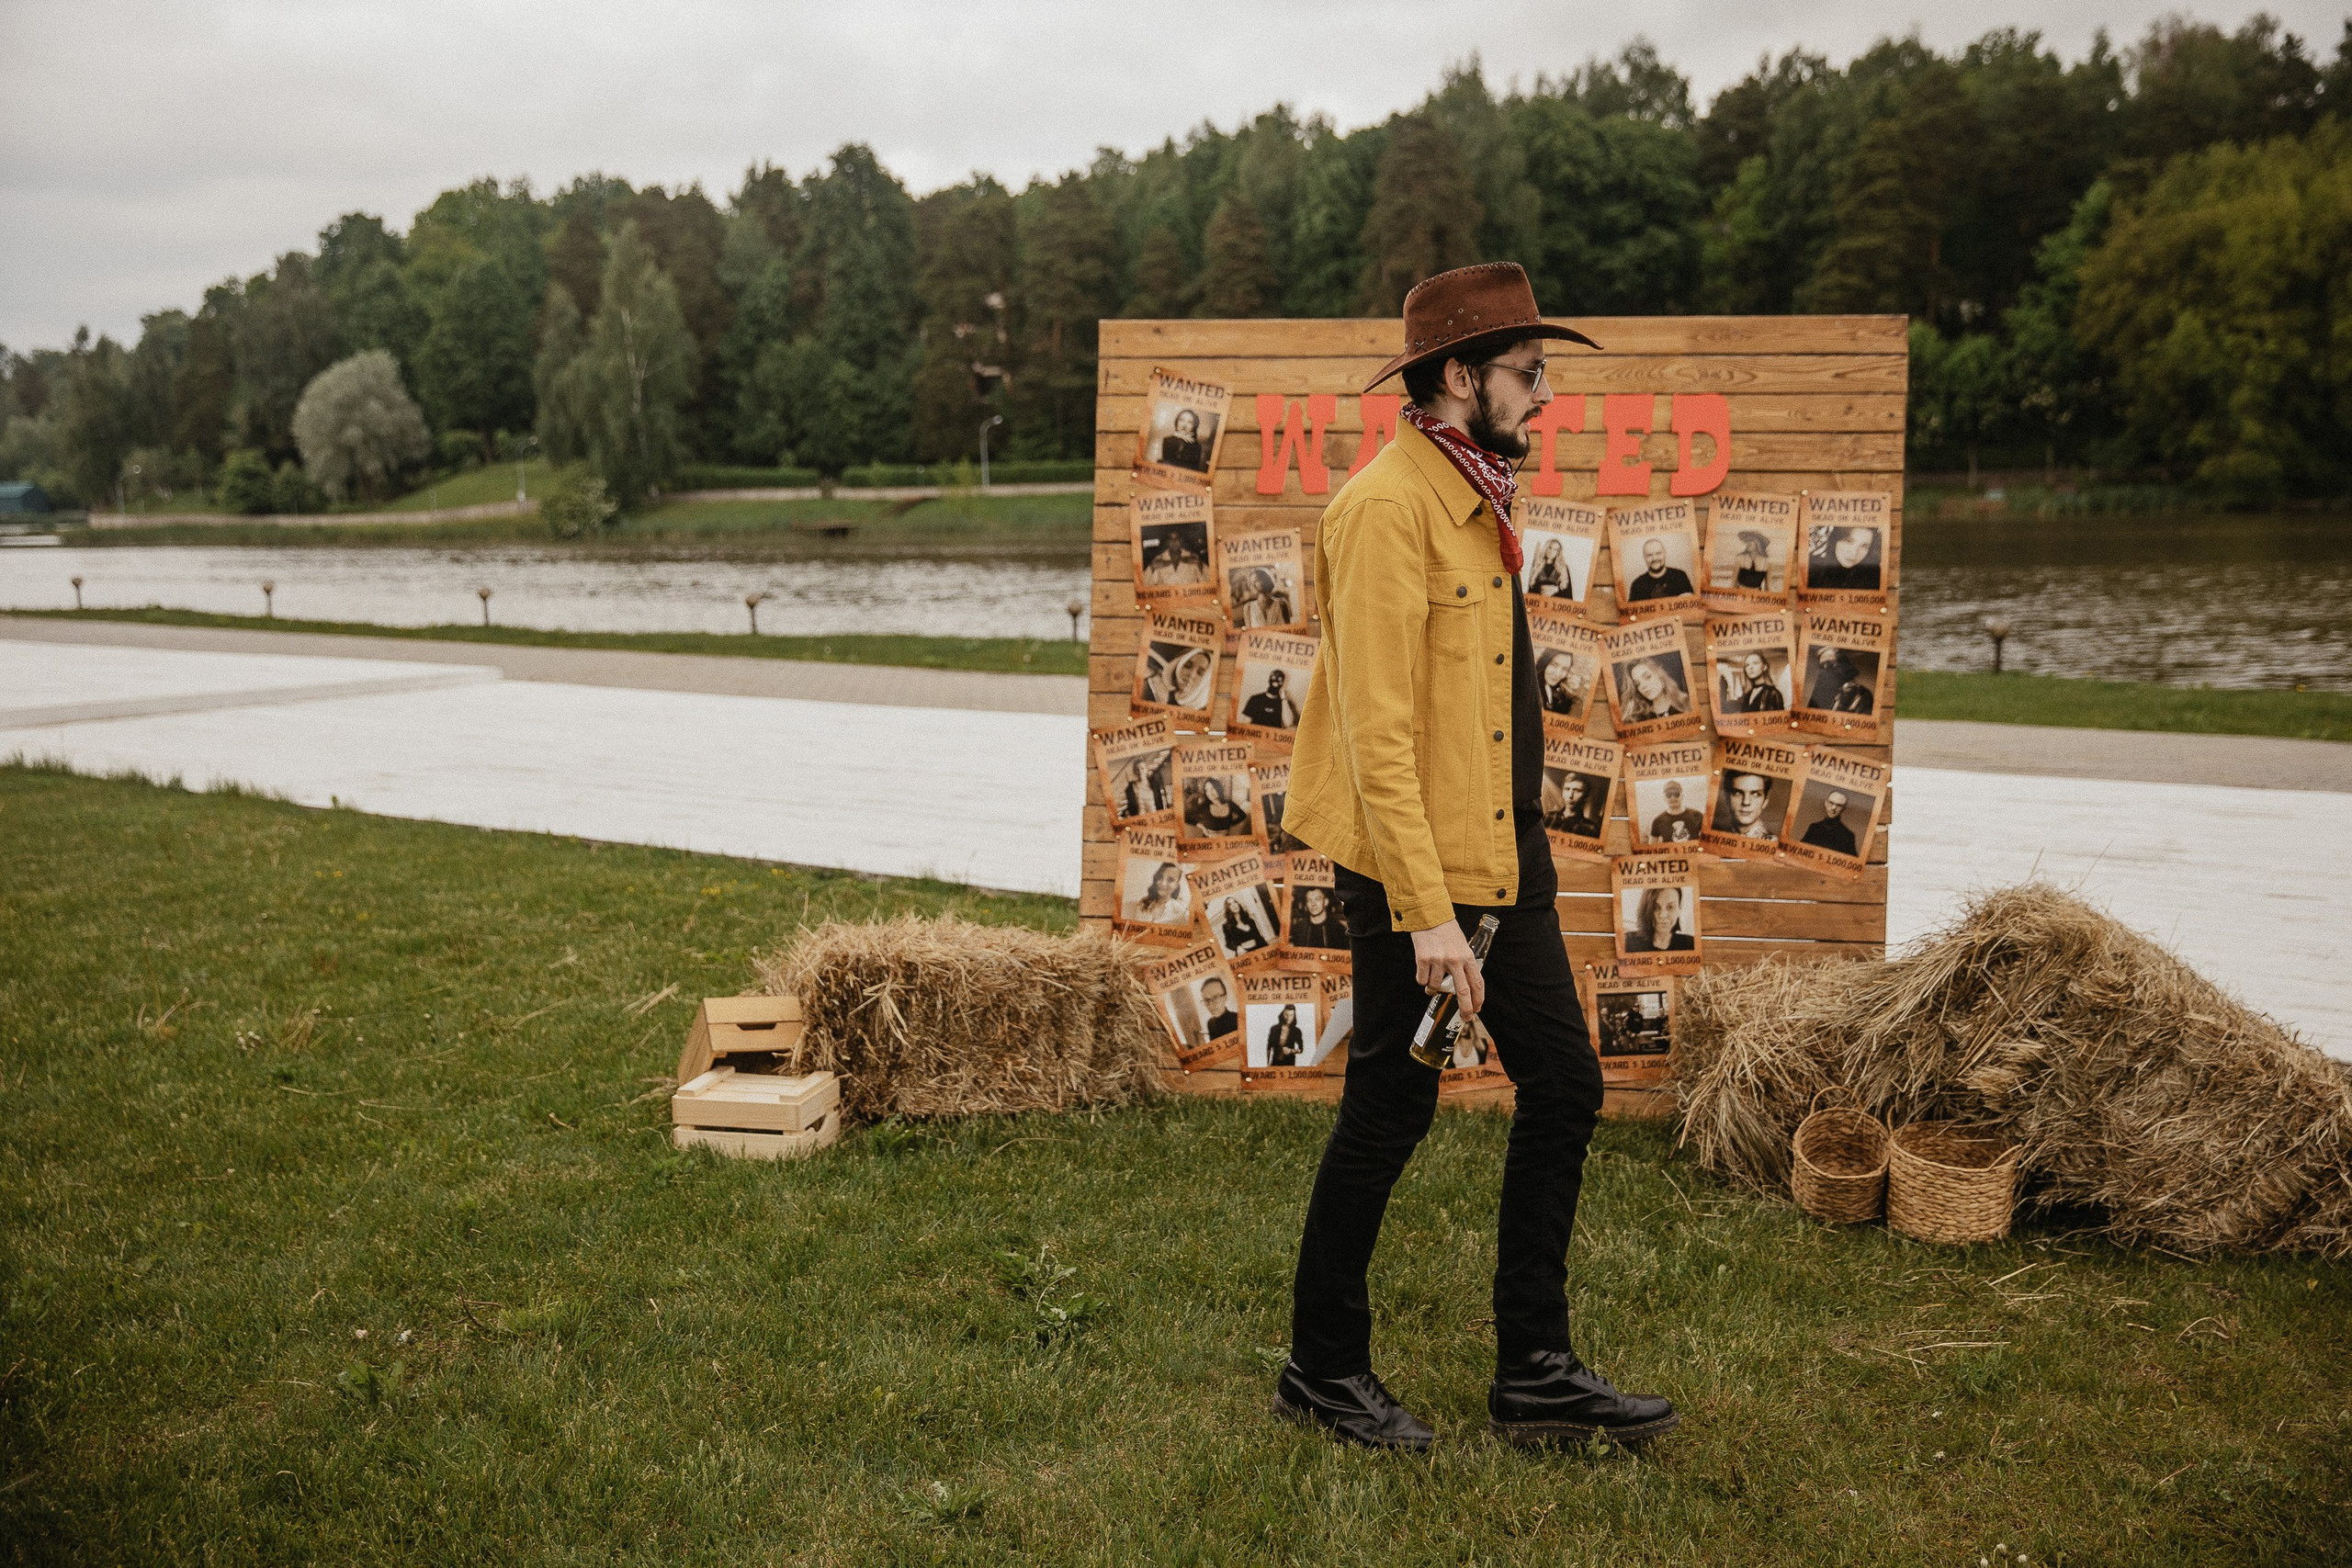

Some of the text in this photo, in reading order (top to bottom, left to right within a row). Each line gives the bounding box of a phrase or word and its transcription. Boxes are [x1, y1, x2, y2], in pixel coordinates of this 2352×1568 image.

[1159, 375, 1225, 399] WANTED
[1256, 393, 1731, 496] WTED
[1137, 494, 1204, 511] WANTED
[1718, 495, 1790, 514] WANTED
[1809, 497, 1882, 513] WANTED
[1526, 503, 1596, 525] WANTED
[1614, 506, 1686, 527] WANTED
[1225, 535, 1292, 553] WANTED
[1152, 613, 1215, 636] WANTED
[1712, 620, 1784, 637] WANTED
[1809, 616, 1882, 637] WANTED
[1605, 624, 1675, 649] WANTED
[1248, 635, 1315, 657] WANTED
[1791, 711, 1828, 723] REWARD
[1102, 720, 1165, 746] WANTED
[1179, 747, 1247, 763] WANTED
[1545, 738, 1613, 762] WANTED
[1631, 749, 1702, 767] WANTED
[1724, 741, 1795, 764] WANTED
[1546, 755, 1566, 764] DEAD
[1584, 762, 1608, 772] ALIVE
[1725, 757, 1790, 775] DEAD OR ALIVE
[1810, 750, 1881, 781] WANTED
[1810, 768, 1831, 778] DEAD
[1849, 779, 1873, 790] ALIVE
[1127, 830, 1176, 847] WANT
[1701, 833, 1737, 848] REWARD
[1778, 841, 1815, 859] REWARD
[1194, 857, 1260, 889] WANTED
[1291, 857, 1330, 873] WAN
[1619, 860, 1689, 874] WANTED
[1202, 874, 1263, 897] DEAD OR ALIVE
[1149, 946, 1216, 980] WANTED
[1279, 951, 1315, 961] REWARD
[1160, 978, 1179, 989] DEAD
[1193, 962, 1216, 975] ALIVE
[1244, 976, 1312, 991] WANTED
[1636, 979, 1660, 987] ALIVE
[1329, 991, 1349, 1002] DEAD
[1241, 1071, 1275, 1079] REWARD
